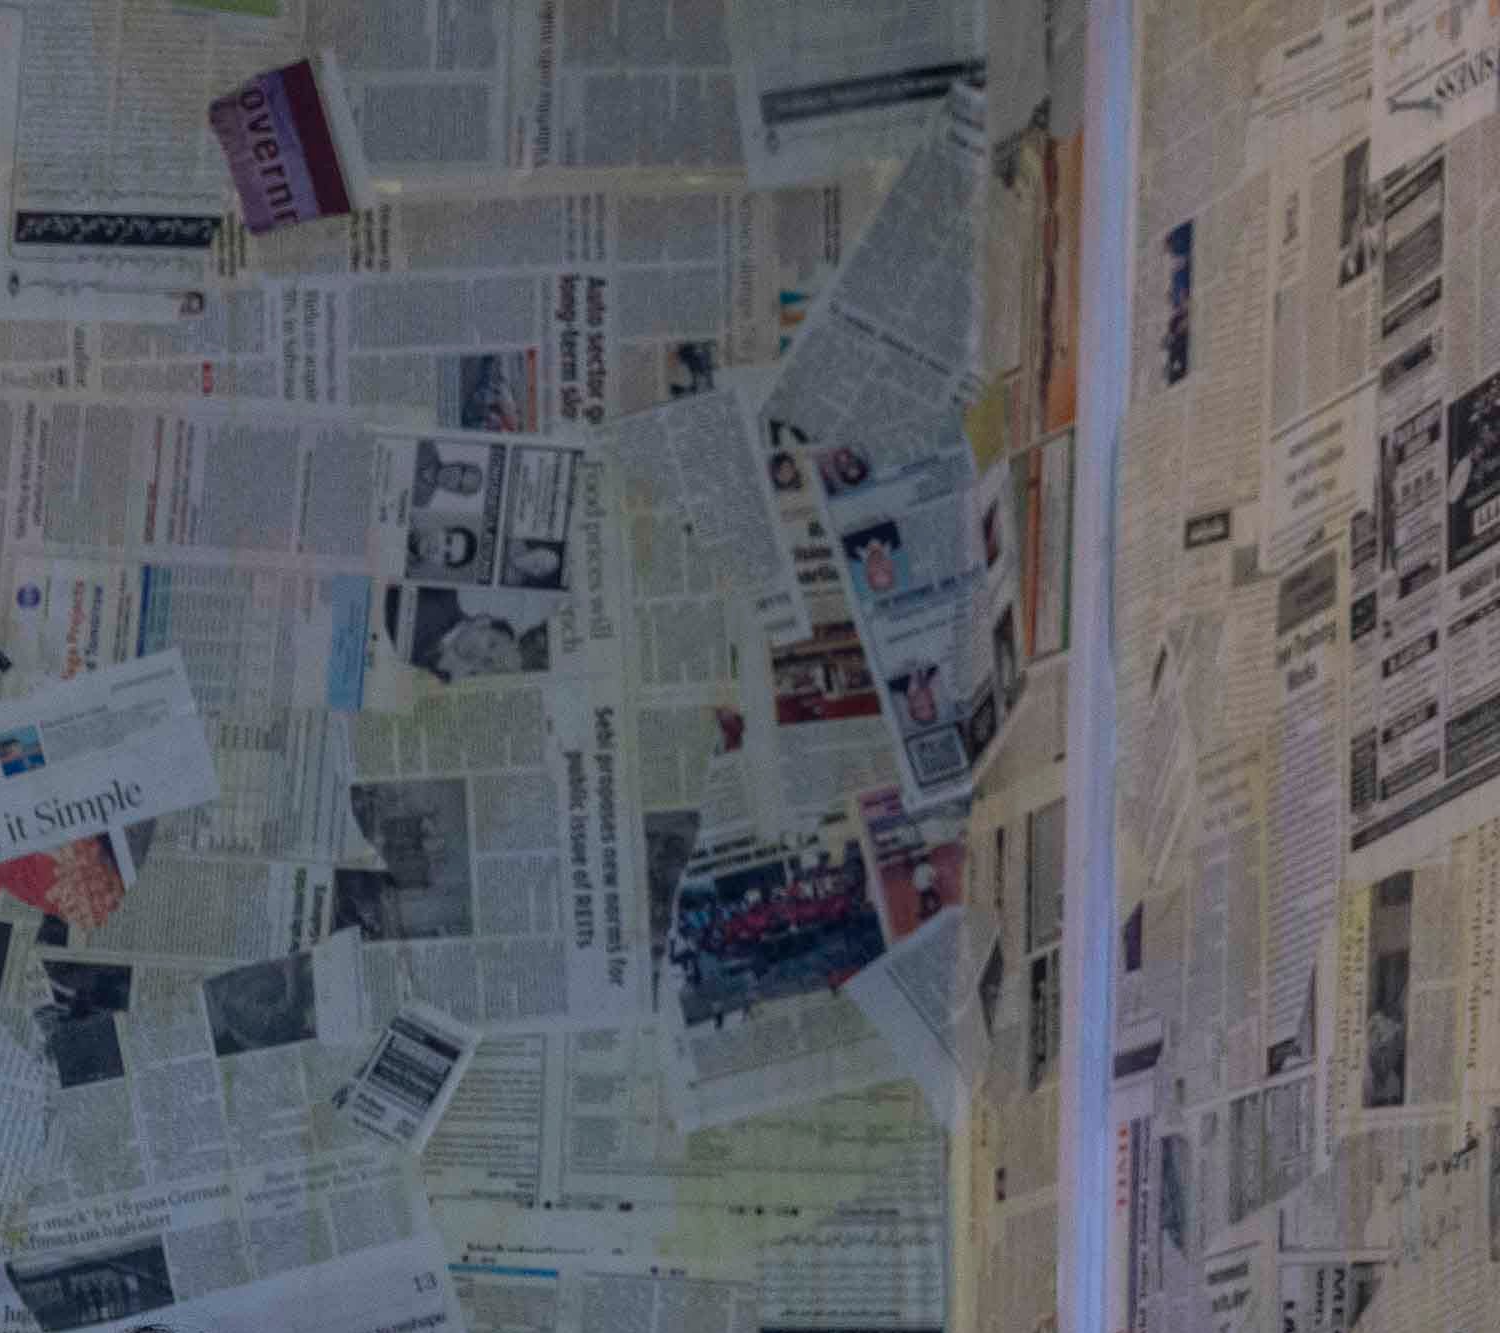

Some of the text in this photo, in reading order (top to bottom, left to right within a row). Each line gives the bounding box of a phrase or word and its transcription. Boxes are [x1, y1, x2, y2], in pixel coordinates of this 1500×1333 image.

[556, 274, 582, 368] long-term
[584, 274, 608, 402] Auto sector
[580, 460, 610, 640] Food prices will
[3, 811, 28, 837] it
[33, 776, 144, 836] Simple
[562, 749, 588, 812] public
[567, 815, 589, 860] issue
[568, 864, 589, 888] of
[592, 705, 626, 987] Sebi proposes new norms for
